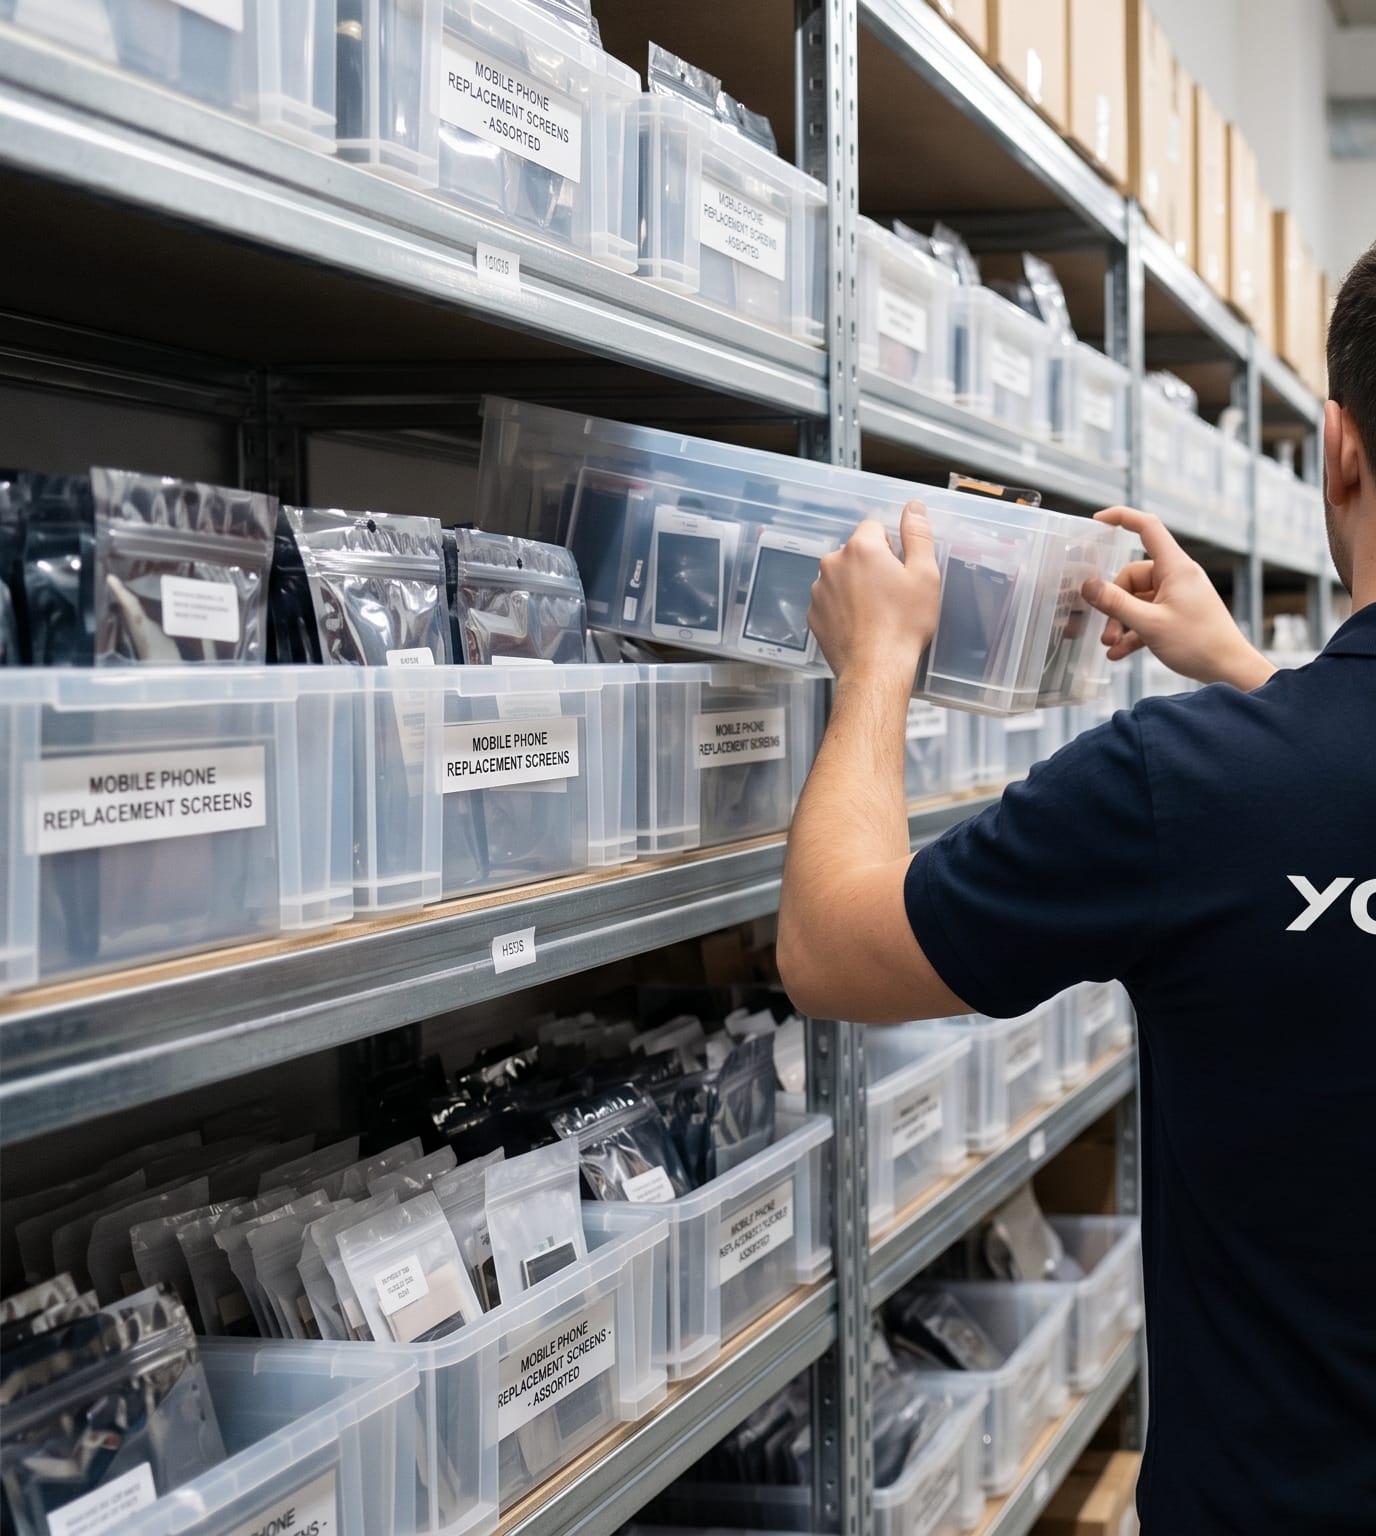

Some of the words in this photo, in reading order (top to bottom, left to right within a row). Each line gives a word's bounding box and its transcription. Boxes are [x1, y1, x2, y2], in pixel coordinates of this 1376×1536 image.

[475, 61, 514, 94] MOBILE
[516, 82, 549, 112] PHONE
[448, 72, 524, 121] REPLACEMENT
[526, 110, 569, 143] SCREENS
[472, 734, 512, 752] MOBILE
[513, 731, 548, 748] PHONE
[89, 771, 156, 794] MOBILE
[160, 767, 216, 788] PHONE
[447, 755, 523, 777] REPLACEMENT
[525, 750, 570, 769] SCREENS
[43, 799, 175, 831] REPLACEMENT
[180, 791, 253, 816] SCREENS
[521, 1341, 556, 1373] MOBILE
[557, 1320, 588, 1350] PHONE
[497, 1355, 564, 1408] REPLACEMENT
[566, 1328, 606, 1364] SCREENS
[533, 1366, 580, 1407] ASSORTED
[250, 1507, 295, 1536] HONE
